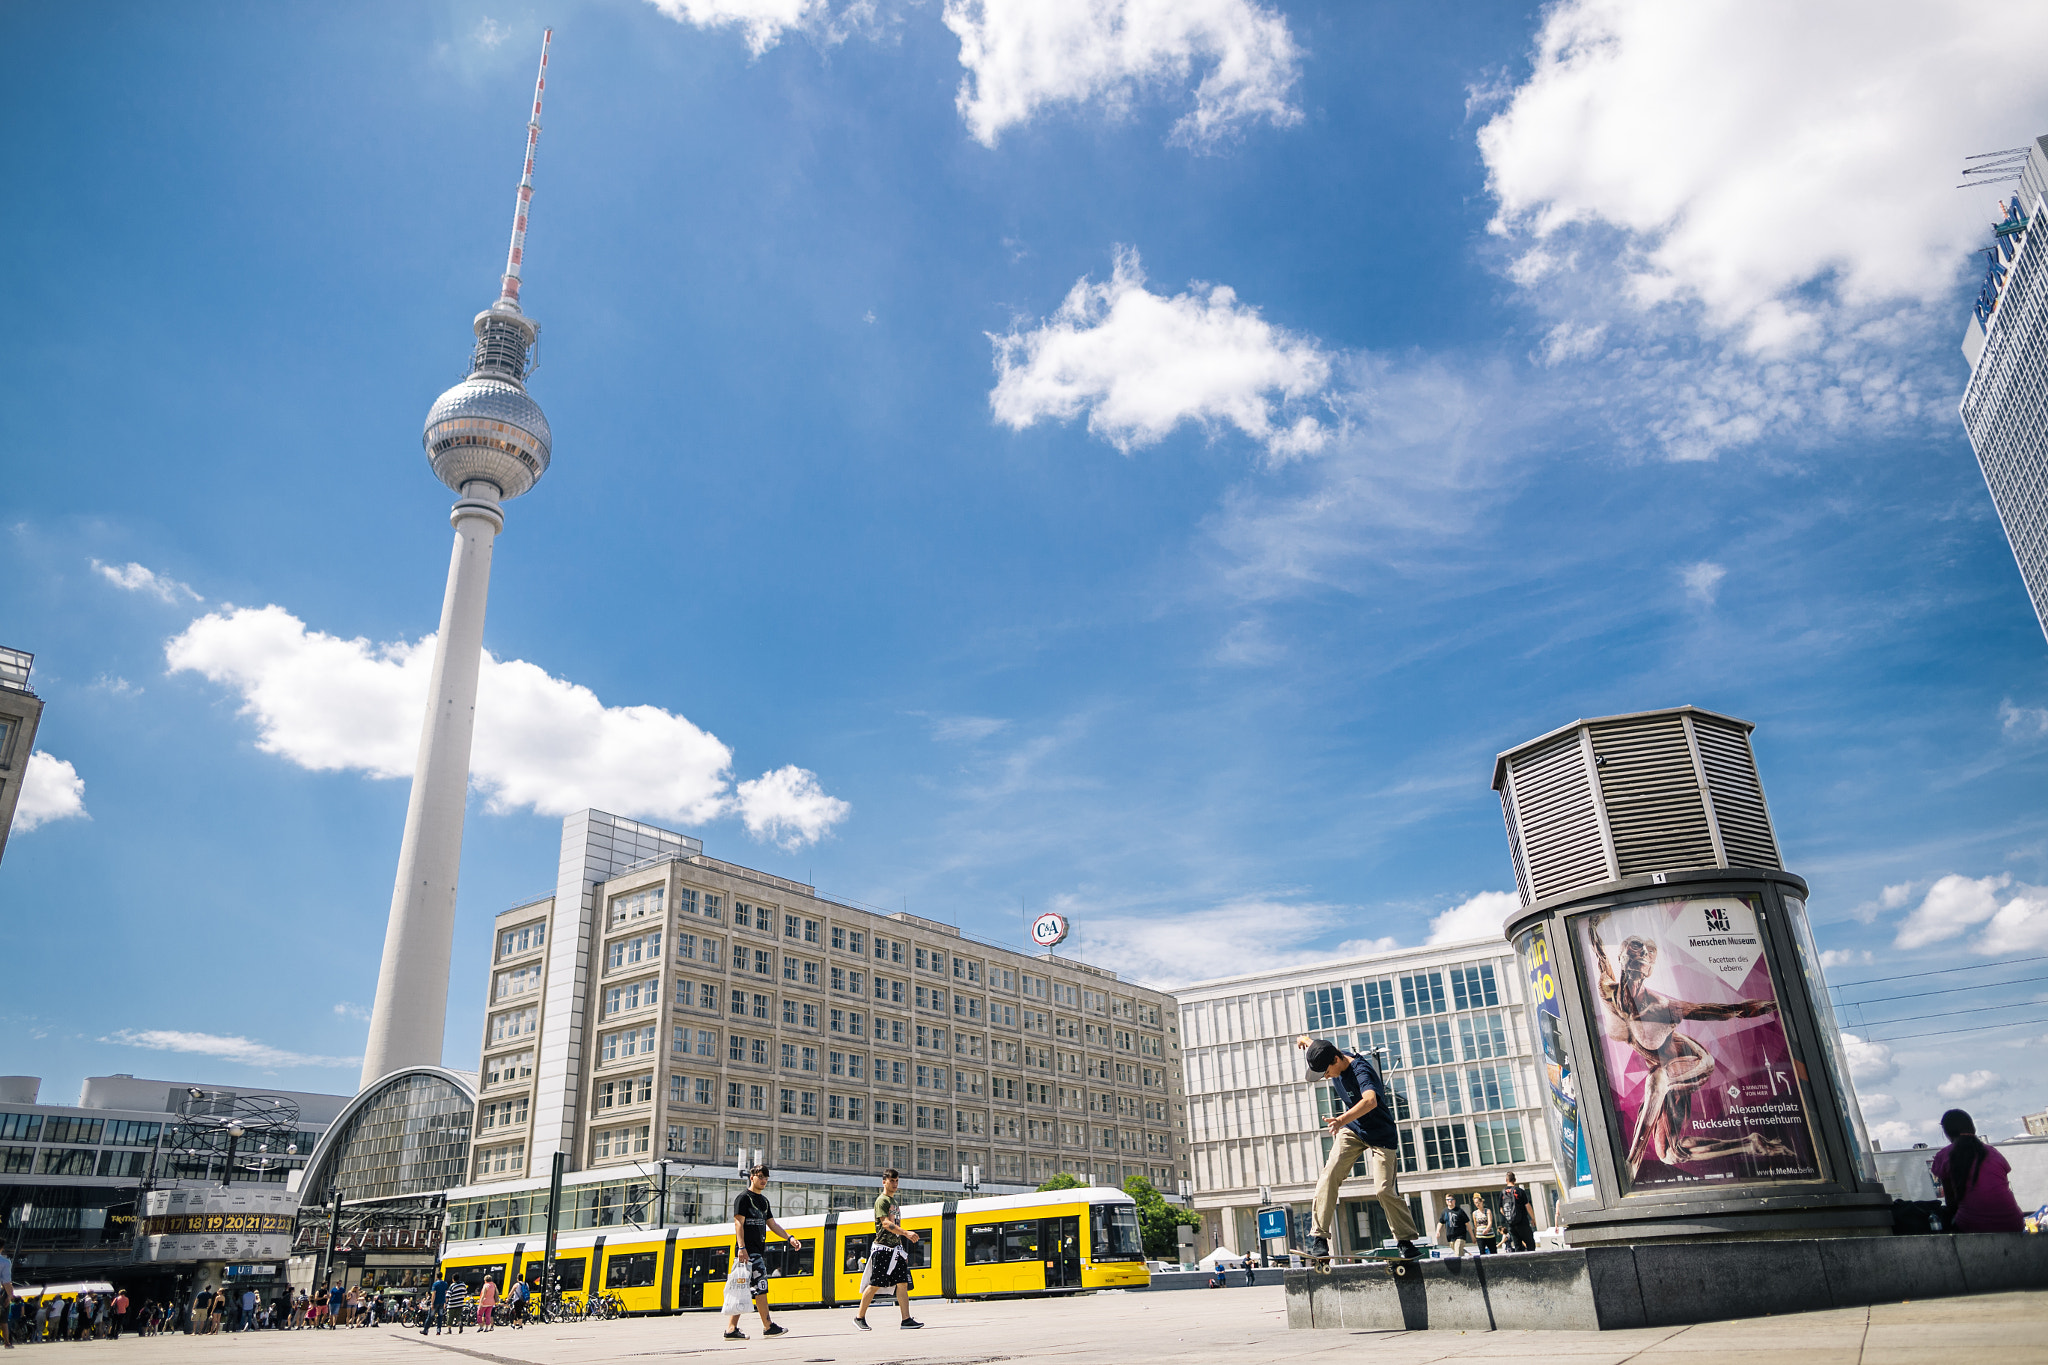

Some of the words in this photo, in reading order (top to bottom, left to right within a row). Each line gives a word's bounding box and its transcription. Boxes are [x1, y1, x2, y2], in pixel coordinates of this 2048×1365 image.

[1657, 873, 1662, 882] 1
[1704, 909, 1728, 920] ME
[1037, 920, 1059, 937] C&A
[1707, 920, 1730, 931] MU
[1689, 938, 1727, 947] Menschen
[1727, 937, 1757, 945] Museum
[1708, 956, 1736, 964] Facetten
[1532, 969, 1554, 1008] nfo
[1729, 1102, 1799, 1114] Alexanderplatz
[1692, 1118, 1741, 1130] Rückseite
[1743, 1115, 1802, 1126] Fernsehturm
[1756, 1166, 1814, 1176] www.MeMu.berlin
[171, 1218, 182, 1230] 17
[188, 1218, 202, 1229] 18
[207, 1218, 223, 1229] 19
[225, 1217, 244, 1229] 20
[246, 1217, 260, 1229] 21
[263, 1217, 276, 1229] 22
[1268, 1213, 1275, 1227] U
[294, 1227, 443, 1249] ALXANDER
